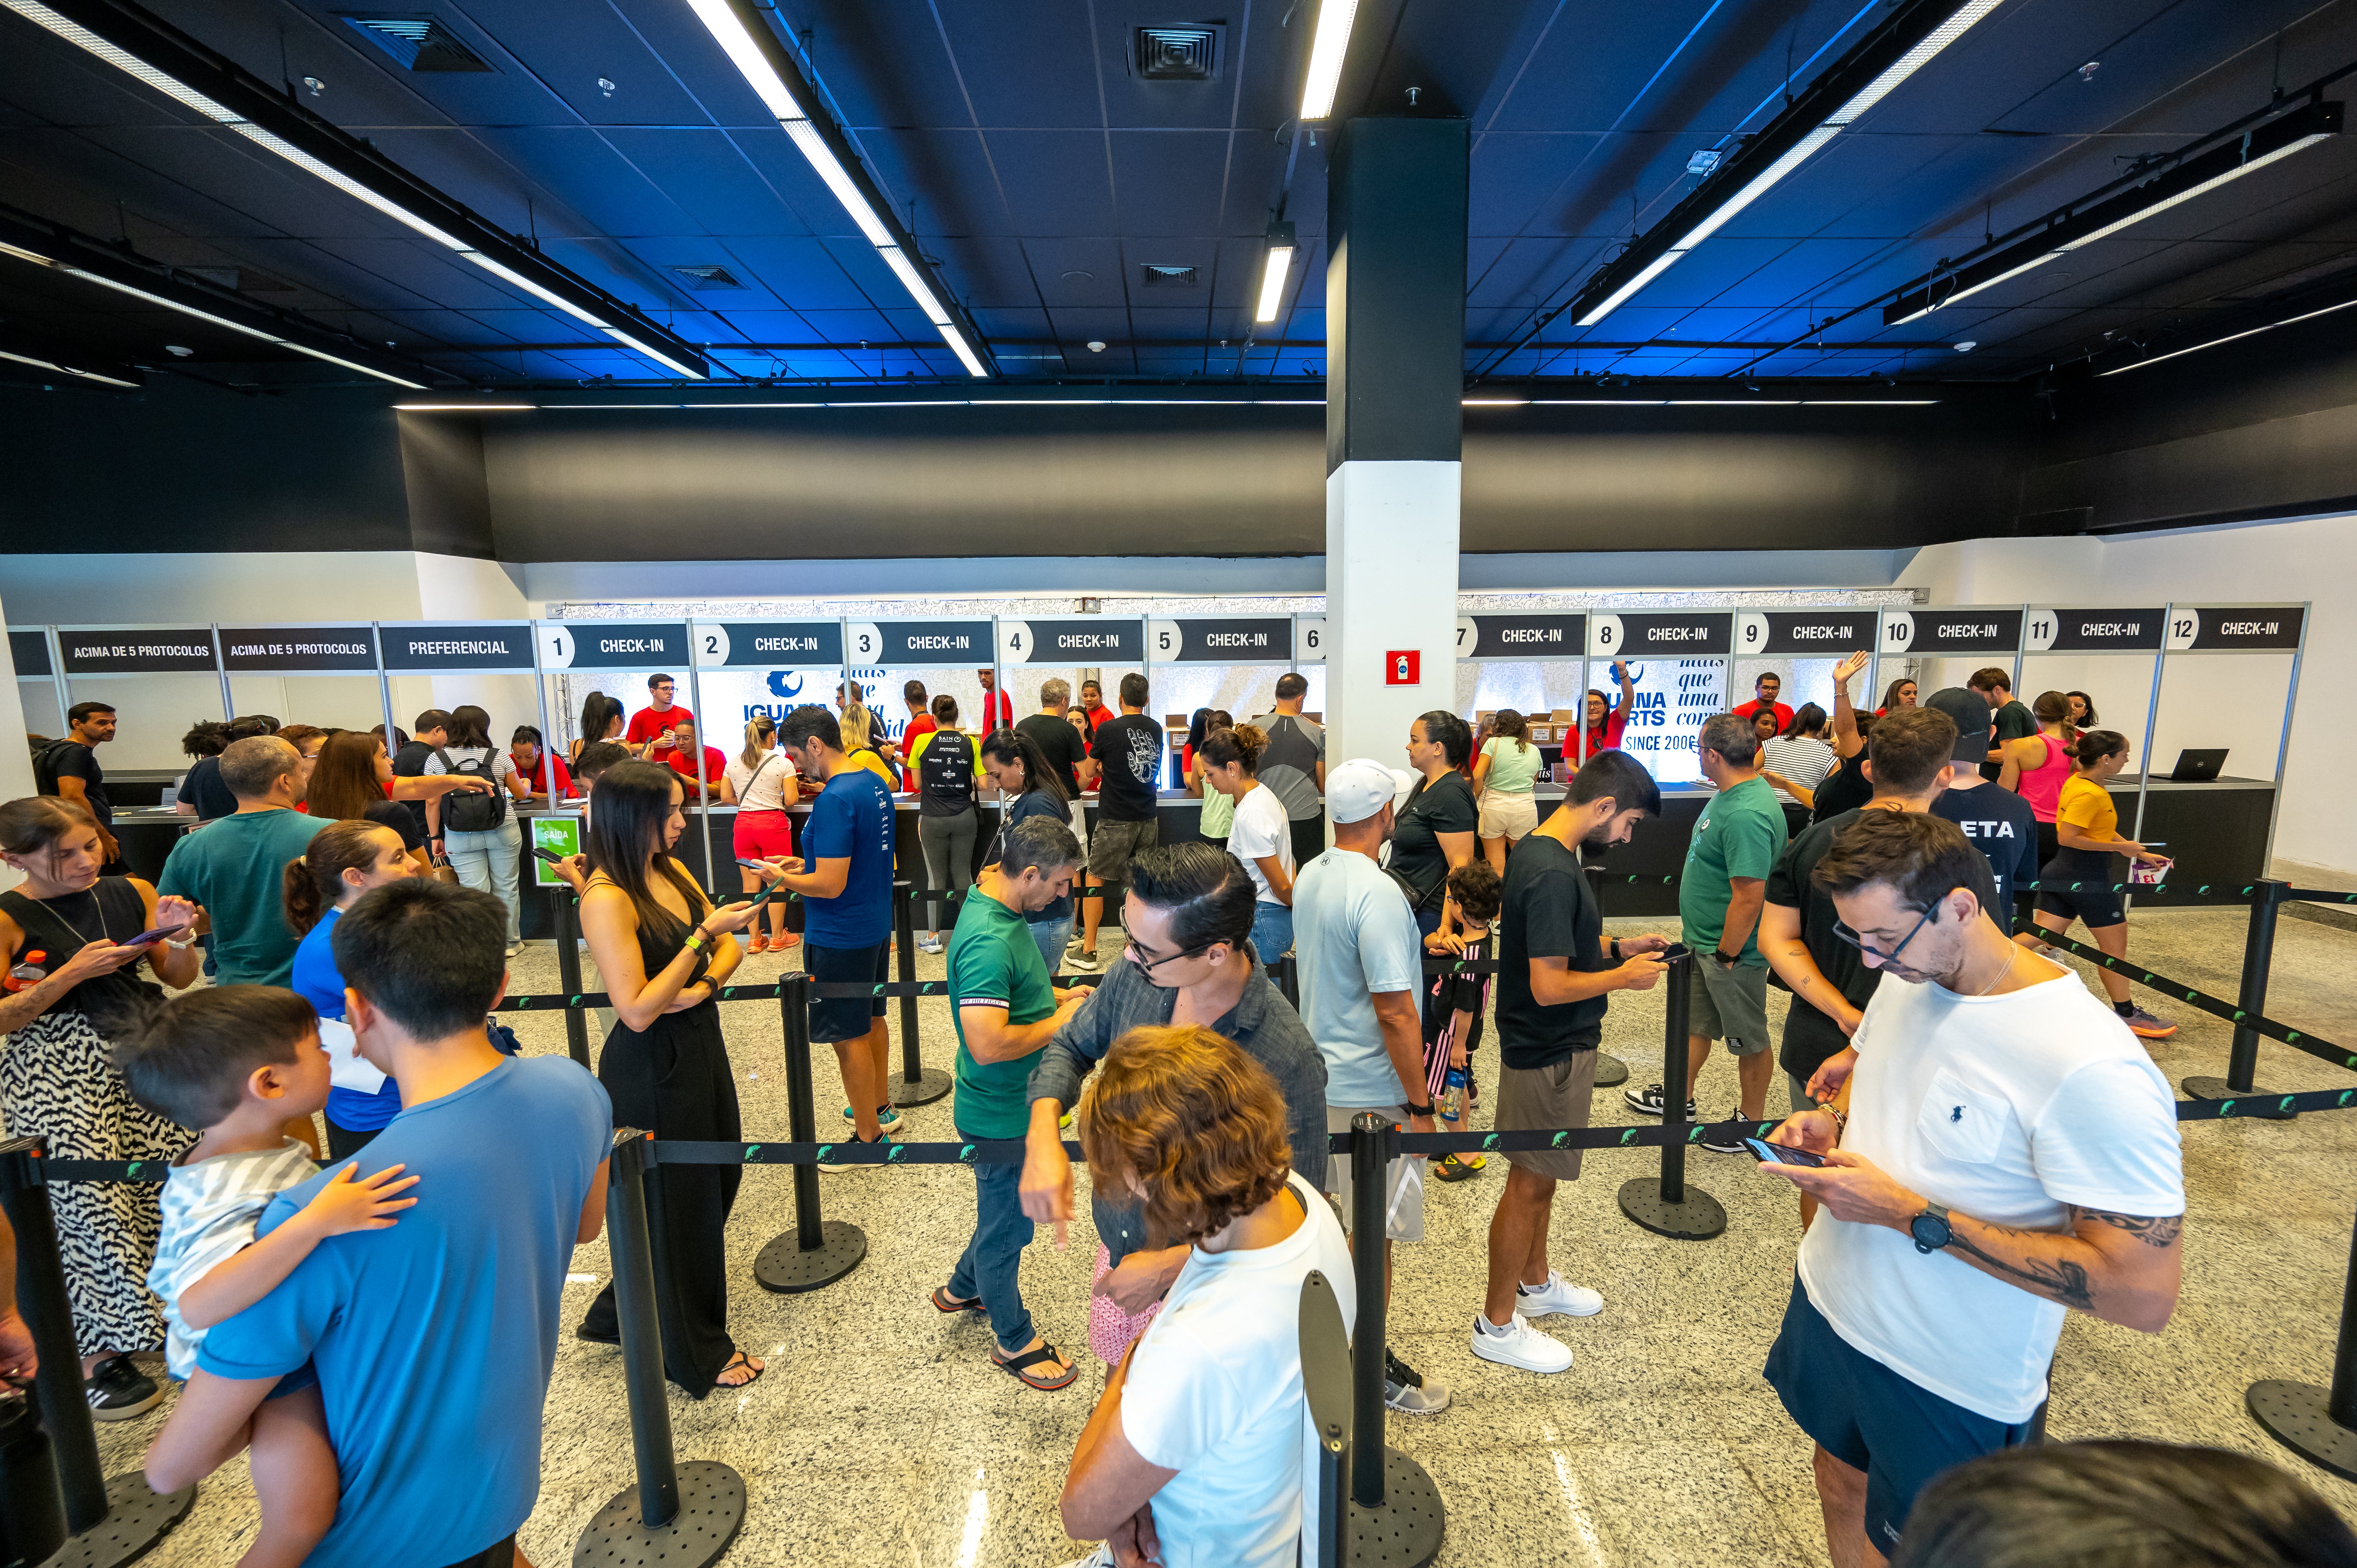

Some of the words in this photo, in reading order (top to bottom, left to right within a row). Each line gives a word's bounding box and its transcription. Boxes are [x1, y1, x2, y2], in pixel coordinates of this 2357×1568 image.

[1601, 626, 1612, 644] 8
[1648, 628, 1708, 641] CHECK-IN
[1746, 625, 1757, 642] 9
[1793, 626, 1852, 639] CHECK-IN
[1888, 623, 1907, 641] 10
[1938, 624, 1997, 637] CHECK-IN
[2032, 621, 2049, 639] 11
[2081, 623, 2140, 636] CHECK-IN
[2174, 620, 2192, 637] 12
[2221, 622, 2279, 635] CHECK-IN
[859, 634, 870, 652] 3
[908, 636, 969, 649] CHECK-IN
[1010, 633, 1021, 651] 4
[1058, 634, 1119, 648] CHECK-IN
[1159, 632, 1170, 649] 5
[1207, 633, 1267, 646] CHECK-IN
[1307, 630, 1319, 648] 6
[1457, 628, 1466, 645] 7
[1502, 629, 1562, 643] CHECK-IN
[231, 645, 266, 656] ACIMA
[269, 644, 284, 655] DE
[286, 644, 293, 654] 5
[296, 643, 367, 655] PROTOCOLOS
[409, 641, 509, 655] PREFERENCIAL
[553, 638, 562, 656] 1
[601, 639, 664, 653] CHECK-IN
[706, 636, 718, 654] 2
[755, 637, 818, 651] CHECK-IN
[74, 646, 110, 658] ACIMA
[112, 646, 127, 657] DE
[129, 646, 136, 656] 5
[139, 645, 209, 657] PROTOCOLOS
[1679, 673, 1713, 692] que
[1678, 693, 1719, 706] uma
[1626, 736, 1661, 750] SINCE
[544, 828, 569, 839] SAÍDA
